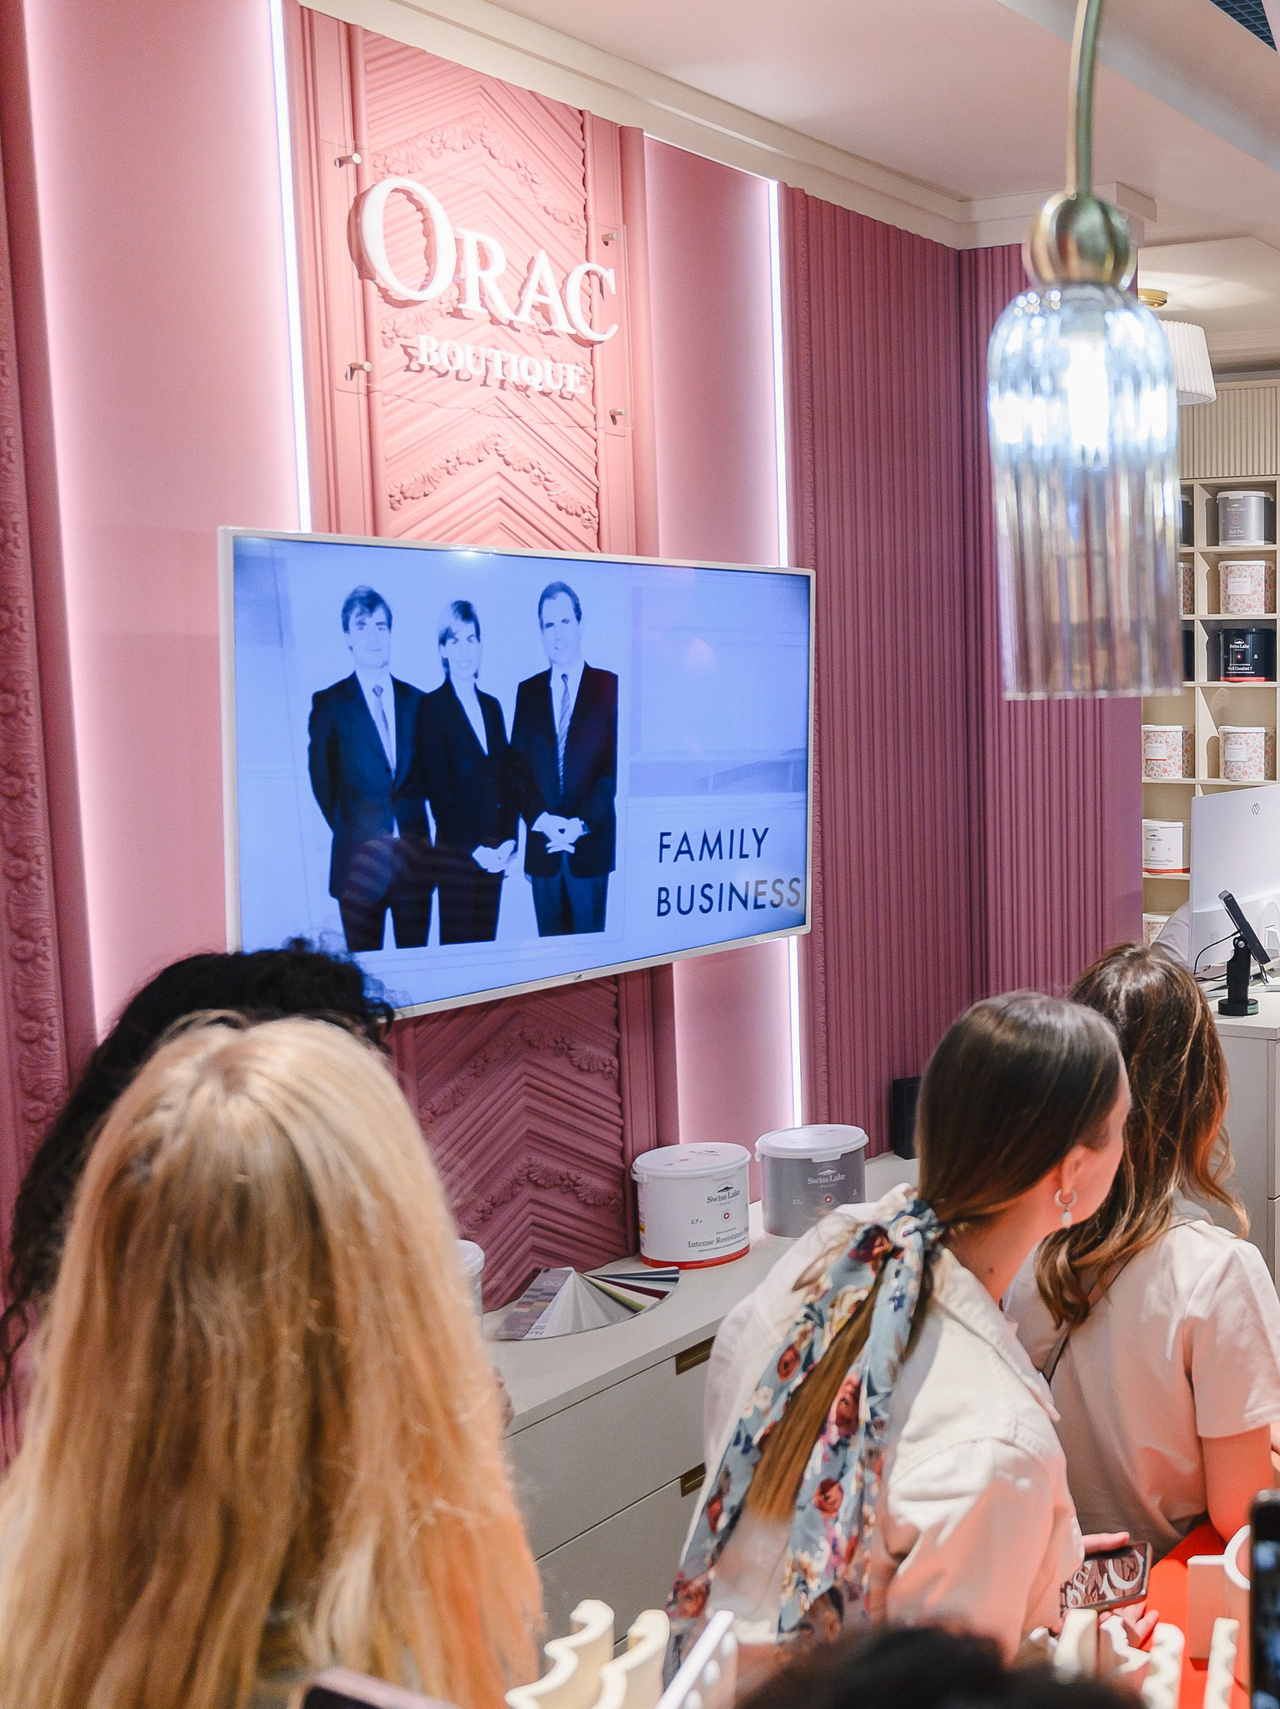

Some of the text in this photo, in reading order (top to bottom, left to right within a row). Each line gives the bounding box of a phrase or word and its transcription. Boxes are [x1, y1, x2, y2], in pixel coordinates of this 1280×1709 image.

[362, 177, 619, 342] ORAC
[416, 334, 586, 394] BOUTIQUE
[659, 828, 769, 863] FAMILY
[657, 877, 801, 917] BUSINESS
[807, 1173, 846, 1185] Swiss Lake
[706, 1190, 740, 1204] Swiss Lake
[688, 1239, 714, 1248] Intense
